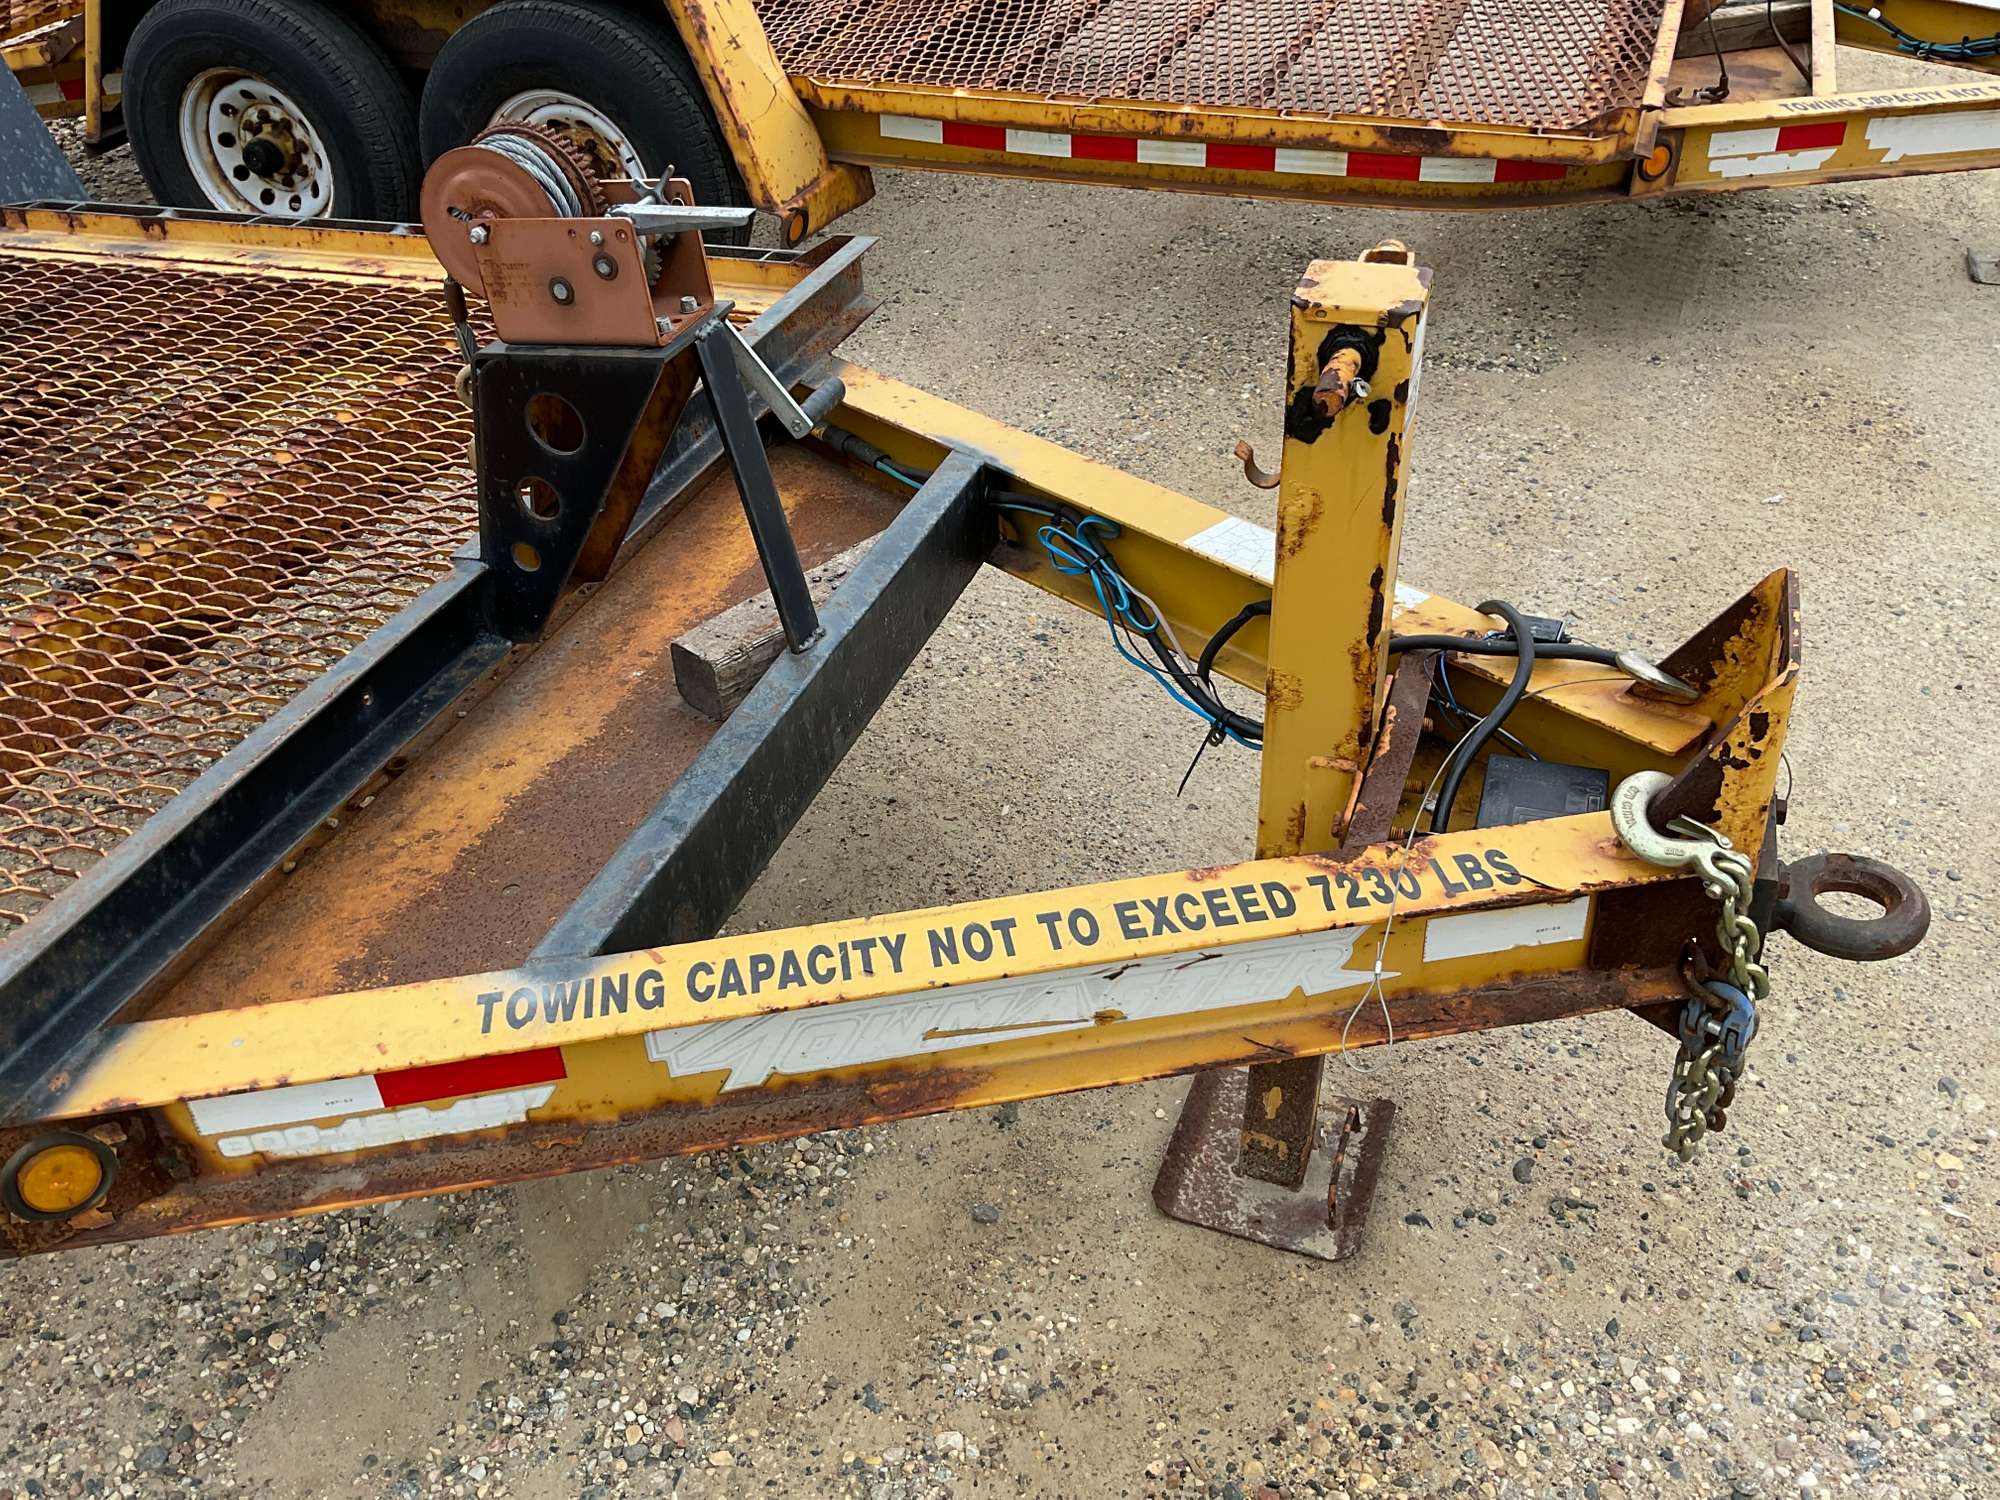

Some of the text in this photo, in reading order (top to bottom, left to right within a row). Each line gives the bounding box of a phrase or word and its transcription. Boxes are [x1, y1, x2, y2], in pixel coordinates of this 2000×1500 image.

[1778, 98, 1856, 112] TOWING
[1857, 90, 1946, 105] CAPACITY
[1946, 87, 1989, 98] NOT
[476, 848, 1522, 1034] TOWING CAPACITY NOT TO EXCEED 7230 LBS
